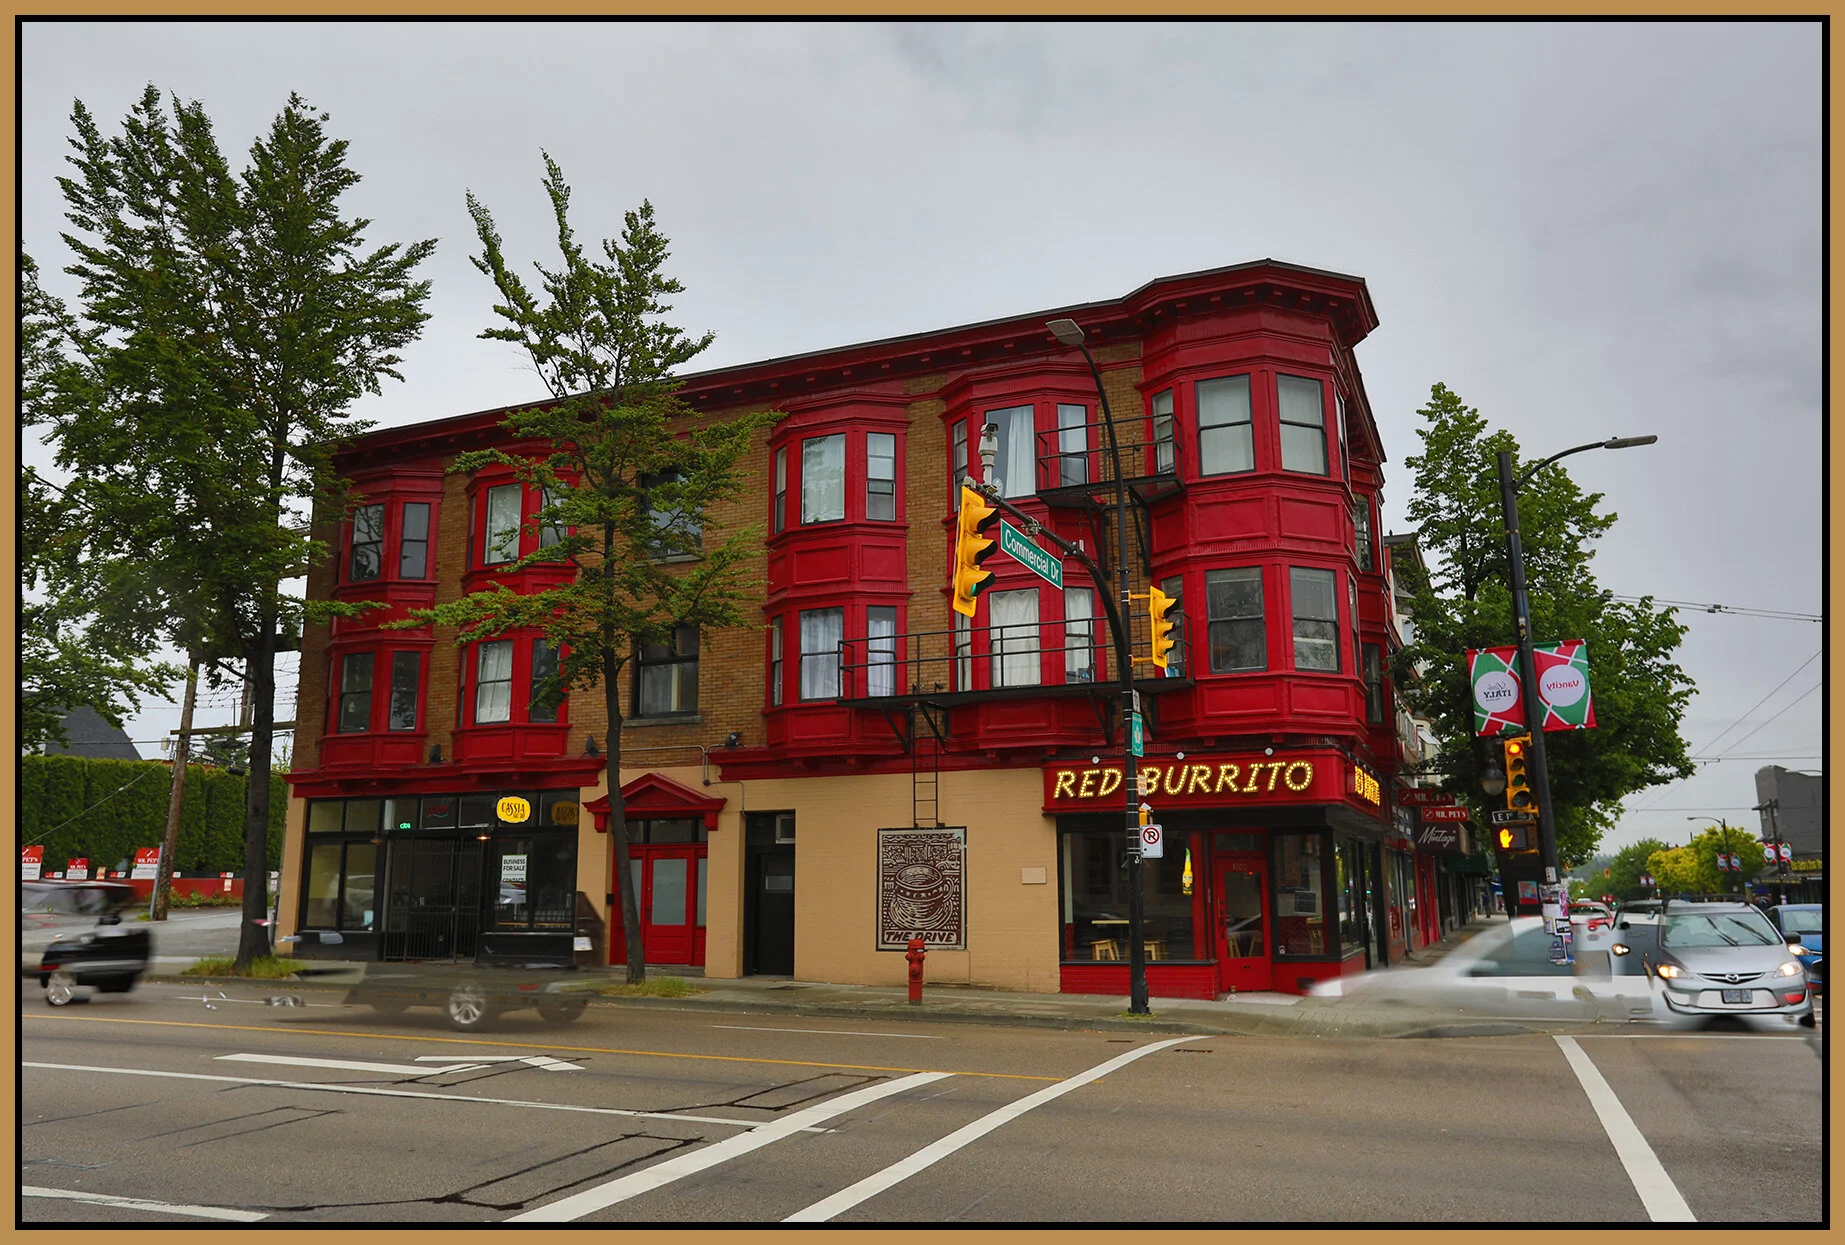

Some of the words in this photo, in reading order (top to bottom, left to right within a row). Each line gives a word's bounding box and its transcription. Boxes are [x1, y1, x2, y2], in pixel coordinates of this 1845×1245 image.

[1005, 529, 1049, 575] Commercial
[1050, 561, 1059, 581] Dr
[1053, 767, 1123, 799] RED
[1139, 760, 1314, 796] BURRITO
[501, 801, 525, 816] CASSIA
[1435, 810, 1447, 818] MR.
[1449, 810, 1467, 818] PET'S
[1417, 825, 1456, 848] Mintage
[886, 931, 912, 942] THE
[914, 931, 954, 943] DRIVE
